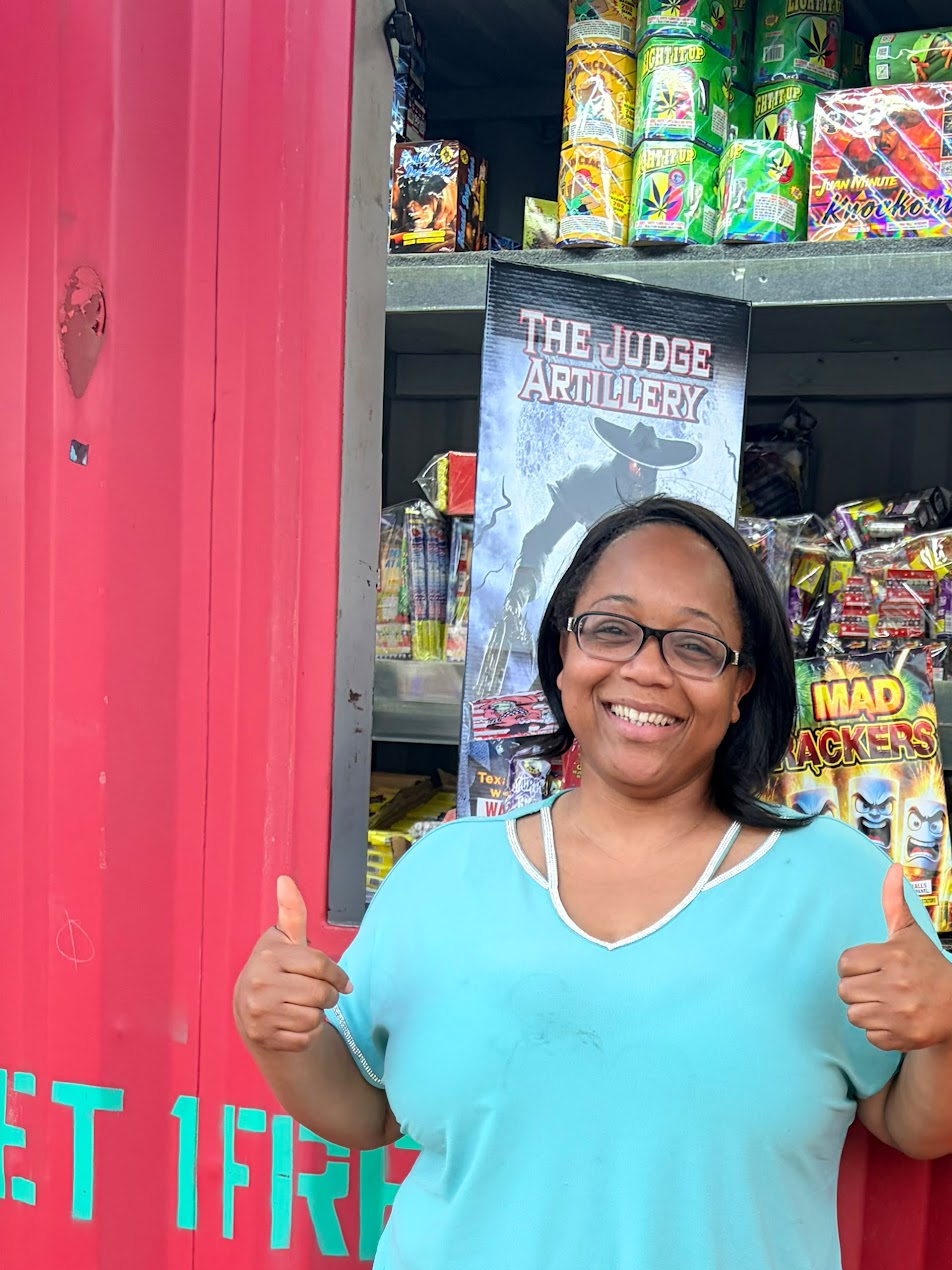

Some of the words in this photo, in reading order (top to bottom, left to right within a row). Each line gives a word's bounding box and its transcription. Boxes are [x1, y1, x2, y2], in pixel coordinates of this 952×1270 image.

[687, 45, 705, 61] UP
[785, 86, 802, 101] UP
[815, 177, 850, 197] JUAN
[851, 173, 898, 190] MINUTE
[519, 308, 592, 362] THE
[599, 324, 713, 380] JUDGE
[518, 357, 708, 423] ARTILLERY
[811, 675, 905, 722] MAD
[222, 1104, 422, 1262] FRE
